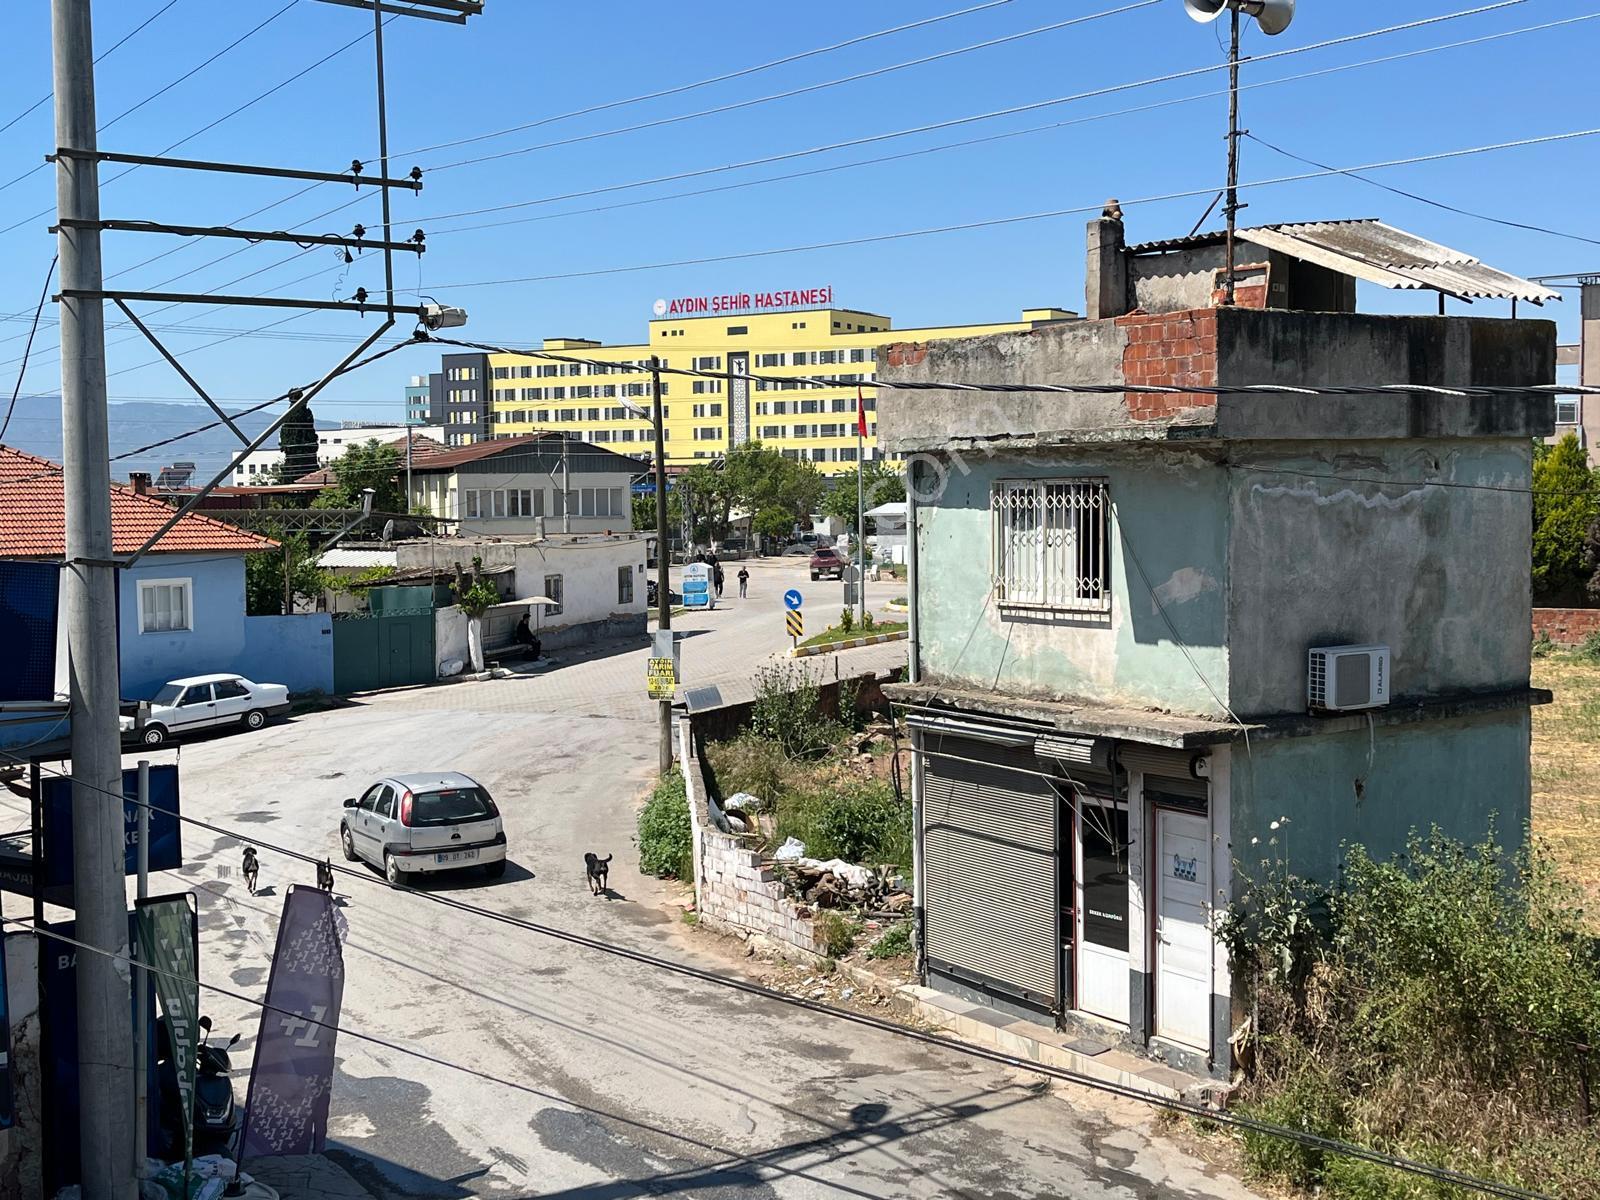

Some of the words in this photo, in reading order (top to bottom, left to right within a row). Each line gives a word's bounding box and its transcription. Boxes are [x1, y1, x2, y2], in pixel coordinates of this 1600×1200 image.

[669, 297, 708, 314] AYDIN
[712, 292, 751, 313] ŞEHİR
[755, 285, 832, 308] HASTANESİ
[280, 1005, 327, 1047] +1
